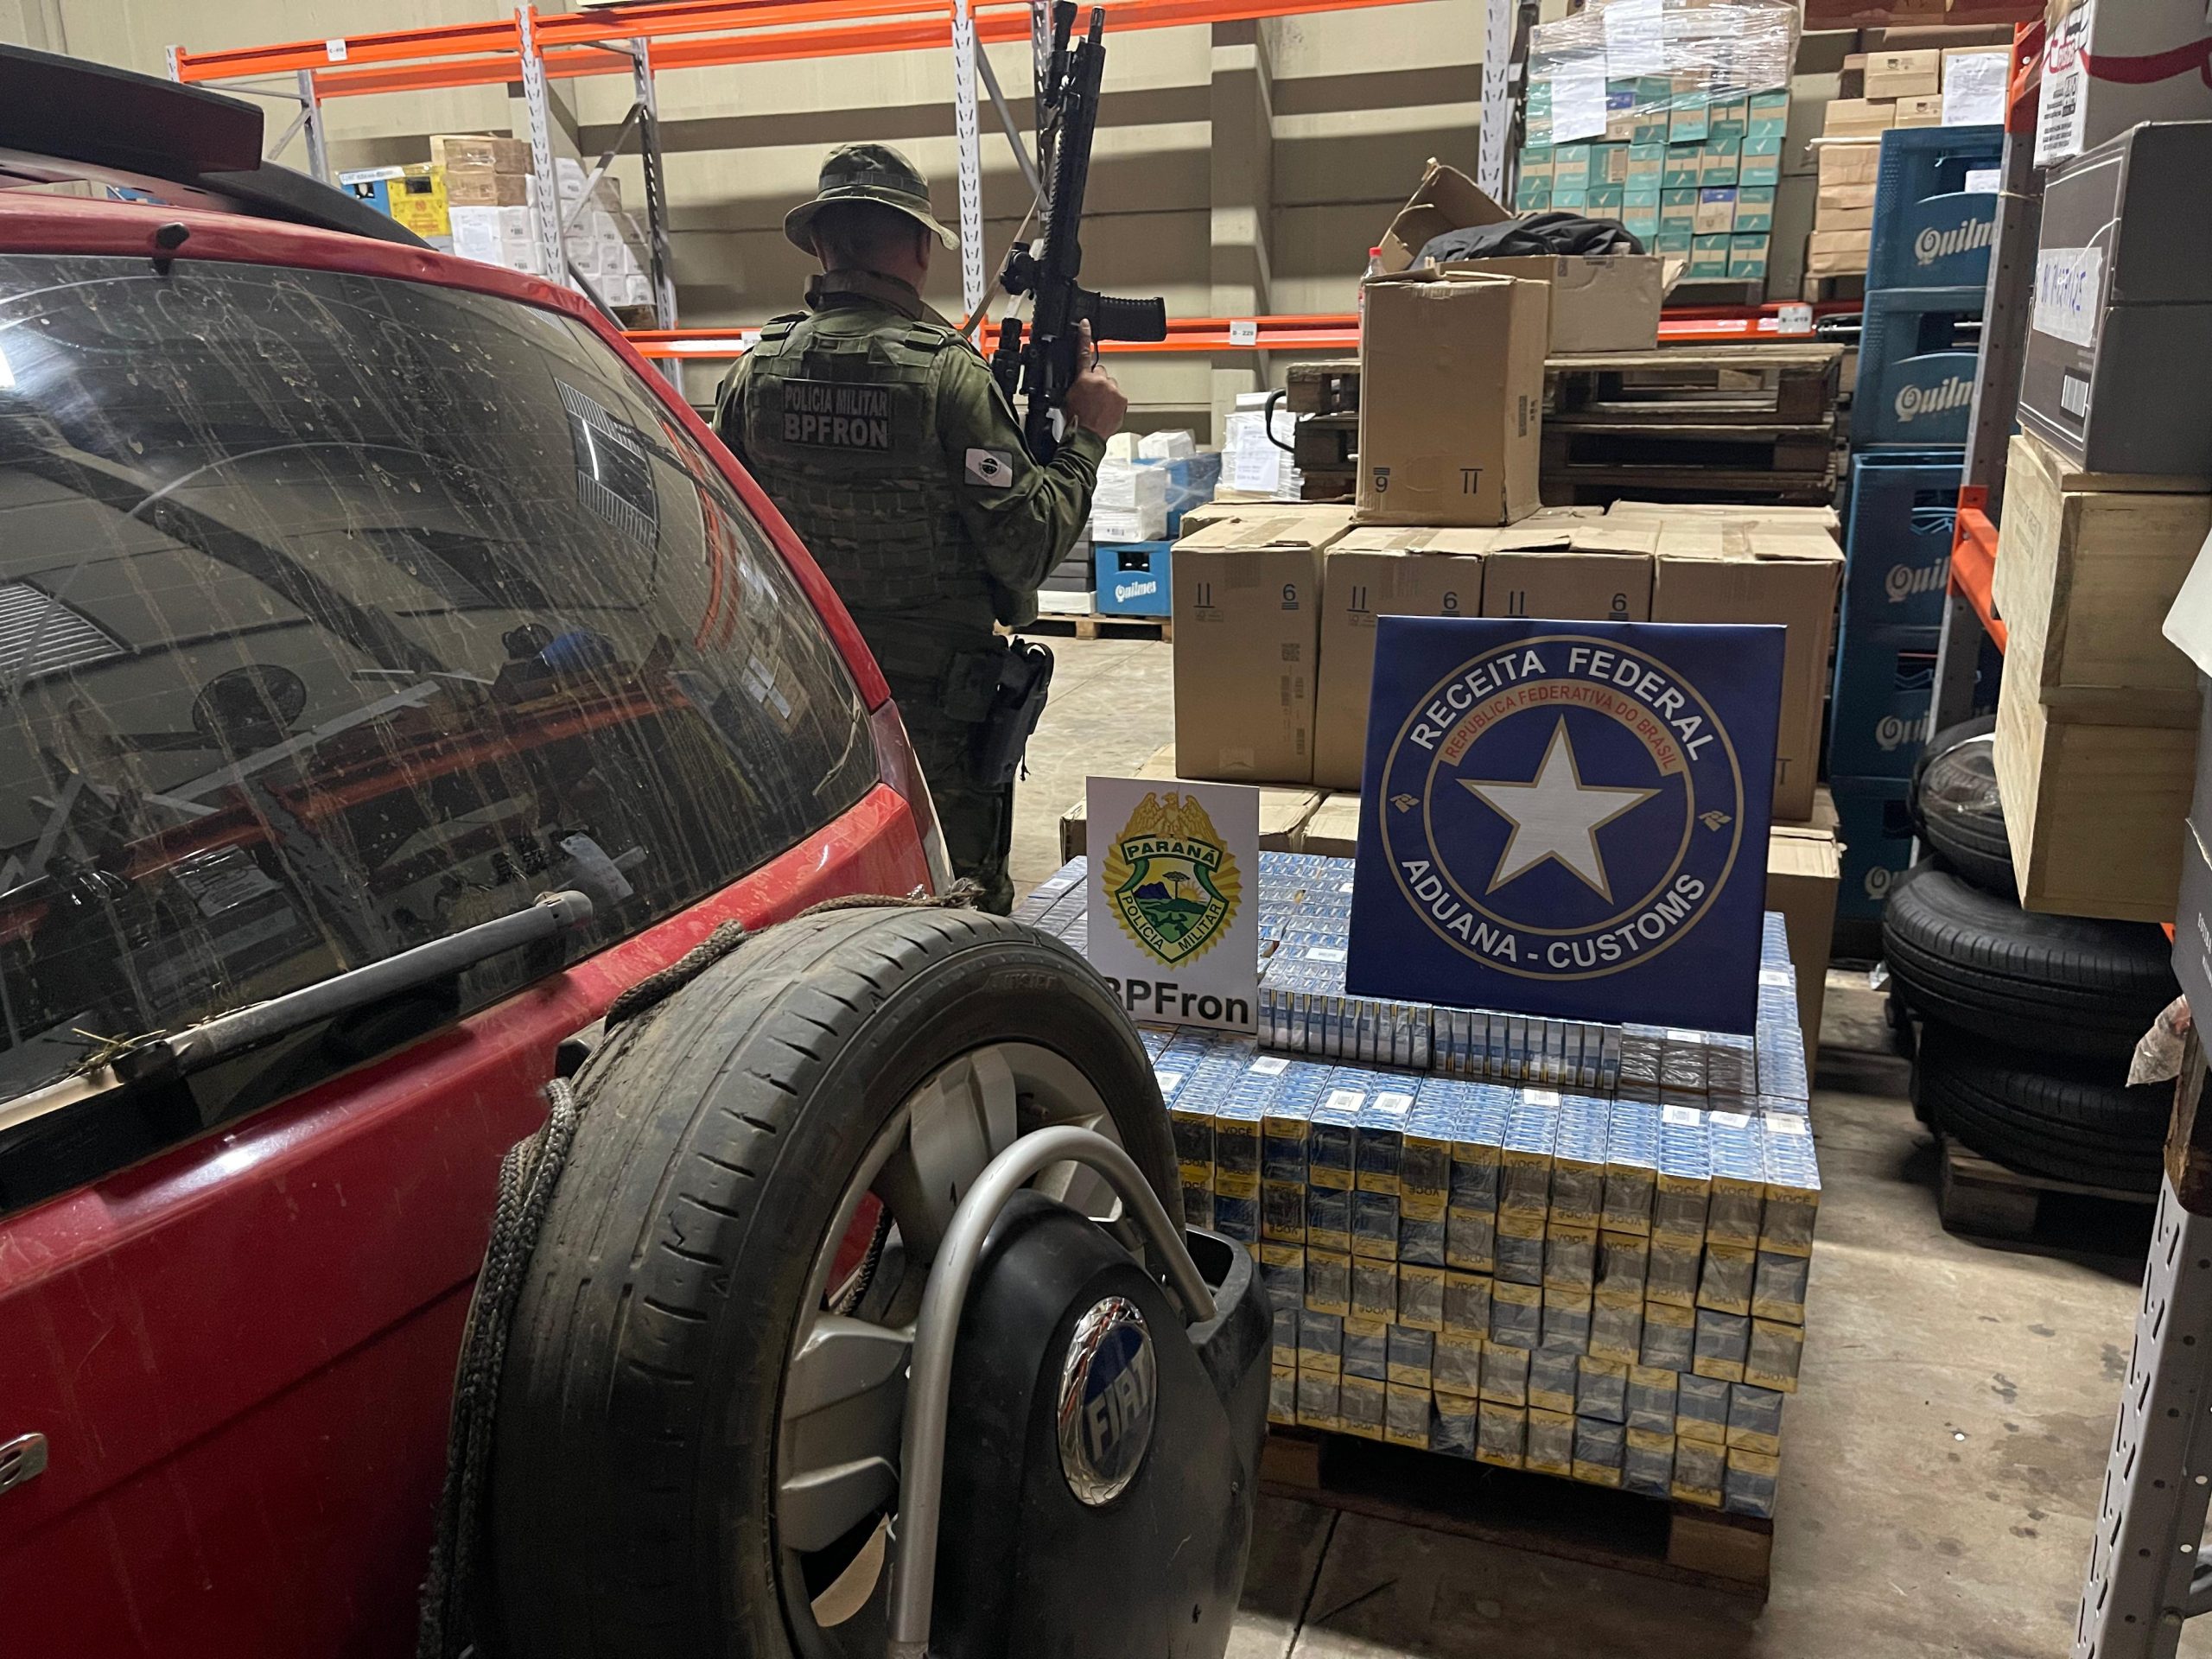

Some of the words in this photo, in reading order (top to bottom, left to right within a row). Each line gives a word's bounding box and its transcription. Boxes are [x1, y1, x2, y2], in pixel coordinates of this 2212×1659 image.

[1915, 218, 1993, 265] Quilm
[836, 388, 887, 416] MILITAR
[1895, 376, 1975, 423] Quilm
[785, 413, 888, 448] BPFRON
[1115, 581, 1157, 603] Quilmes
[1283, 583, 1296, 601] 6
[1443, 591, 1458, 610] 6
[1611, 593, 1627, 612] 6
[1885, 556, 1950, 603] Quil
[1409, 650, 1547, 750] RECEITA
[1567, 647, 1717, 761] FEDERAL
[1517, 685, 1613, 709] FEDERATIVA
[1615, 702, 1638, 721] DO
[1636, 719, 1677, 769] BRASIL
[1127, 842, 1216, 865] PARANÁ
[1178, 904, 1222, 950] MILITAR
[1402, 858, 1519, 963] ADUANA
[1547, 874, 1706, 969] CUSTOMS
[1085, 1343, 1149, 1462] FIAT
